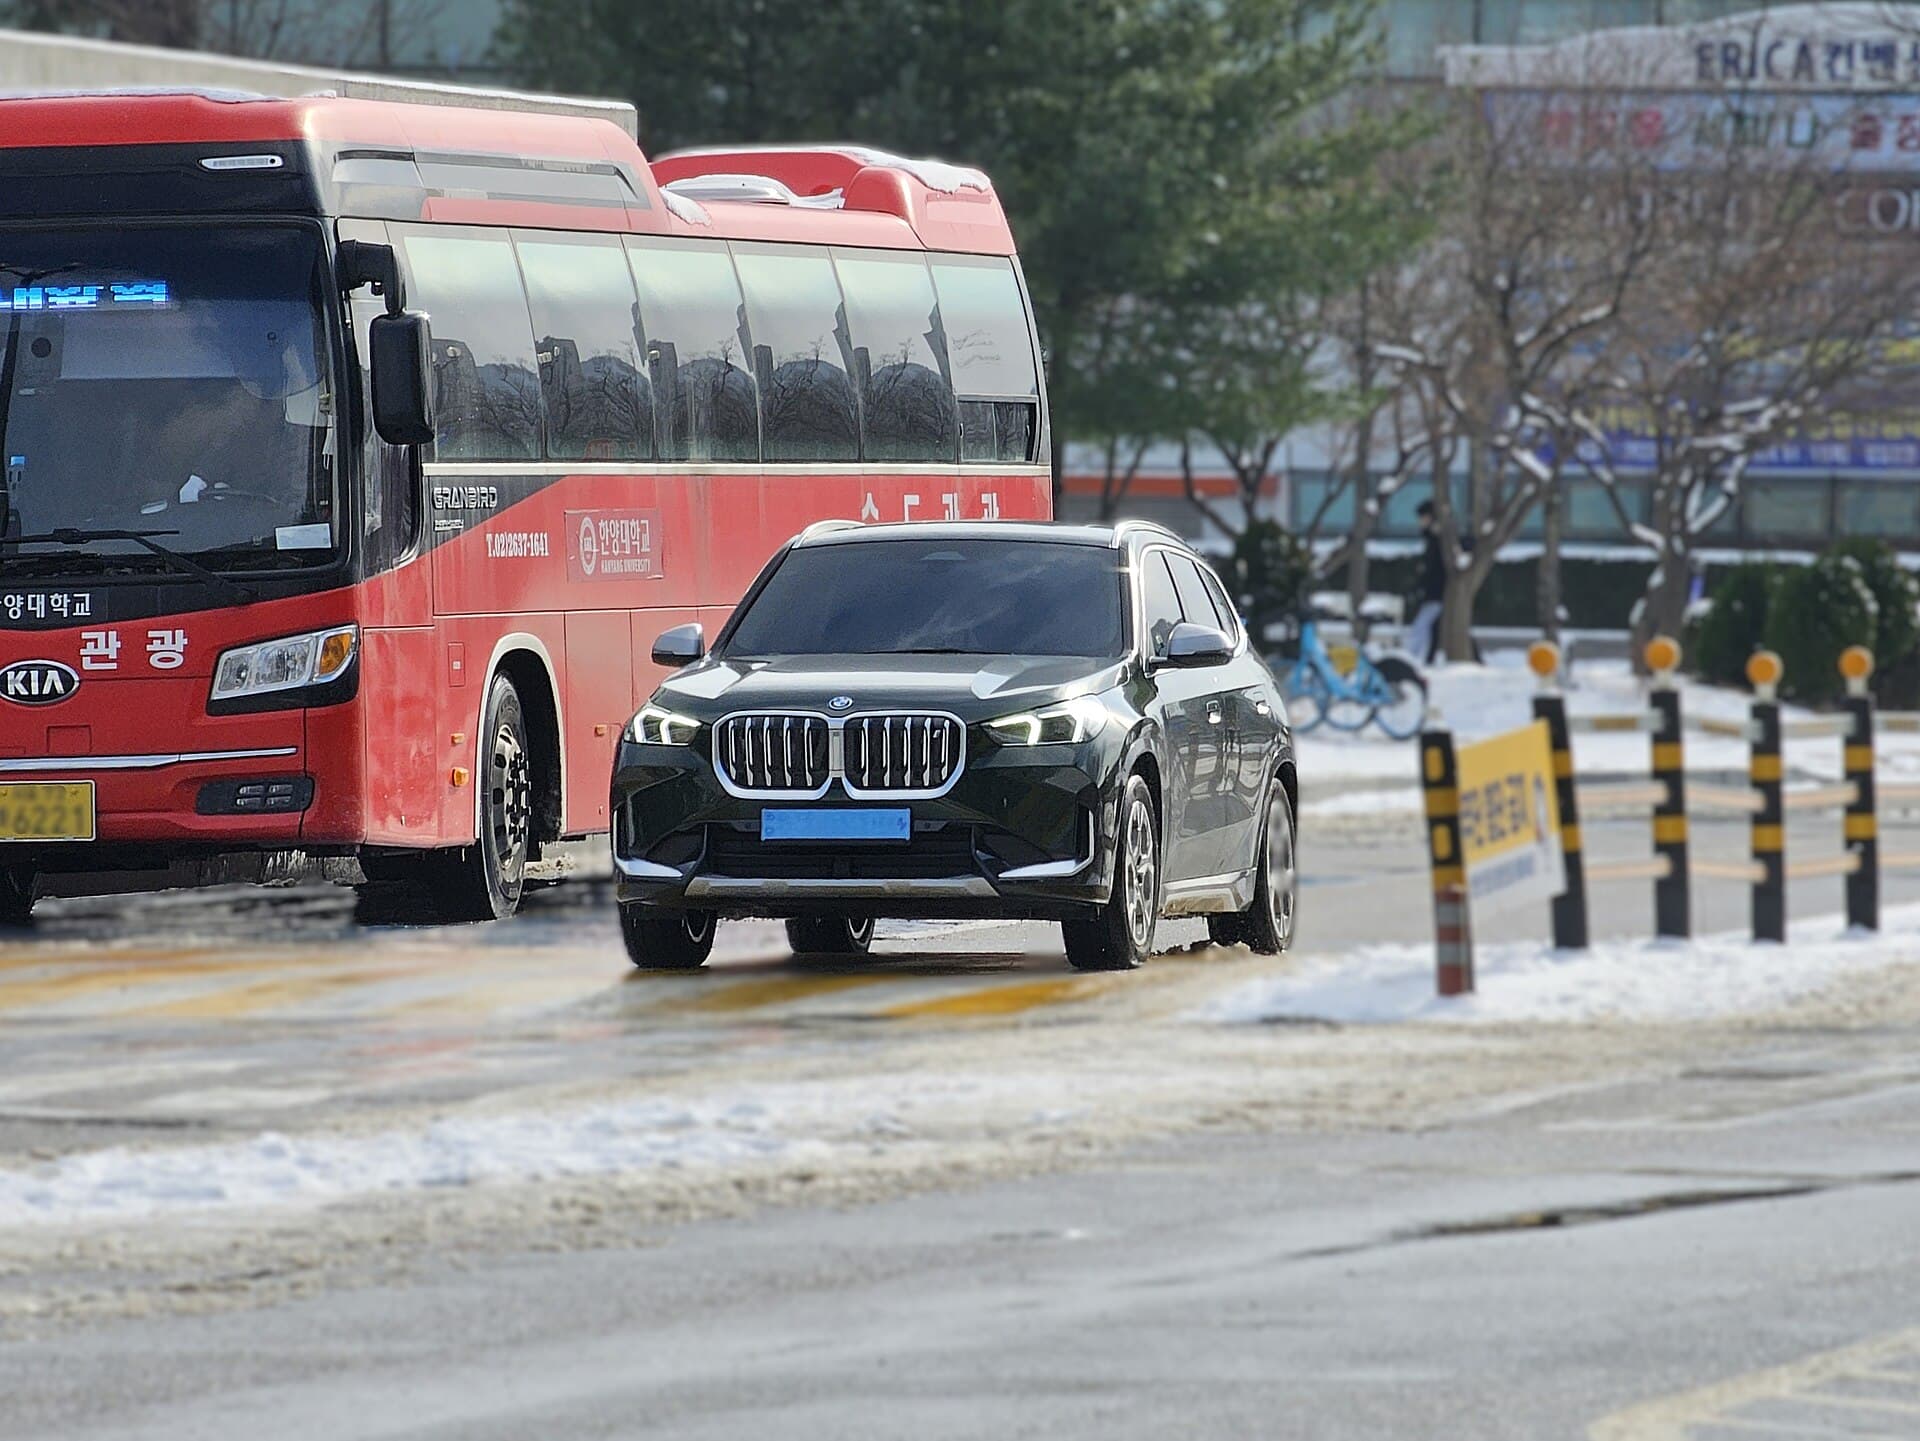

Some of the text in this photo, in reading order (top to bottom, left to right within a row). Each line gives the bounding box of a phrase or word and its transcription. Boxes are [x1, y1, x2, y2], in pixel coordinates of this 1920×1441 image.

[433, 486, 498, 509] GRANBIRD
[598, 518, 651, 556] 한양대학교
[0, 593, 92, 620] 양대학교
[7, 670, 65, 696] KIA
